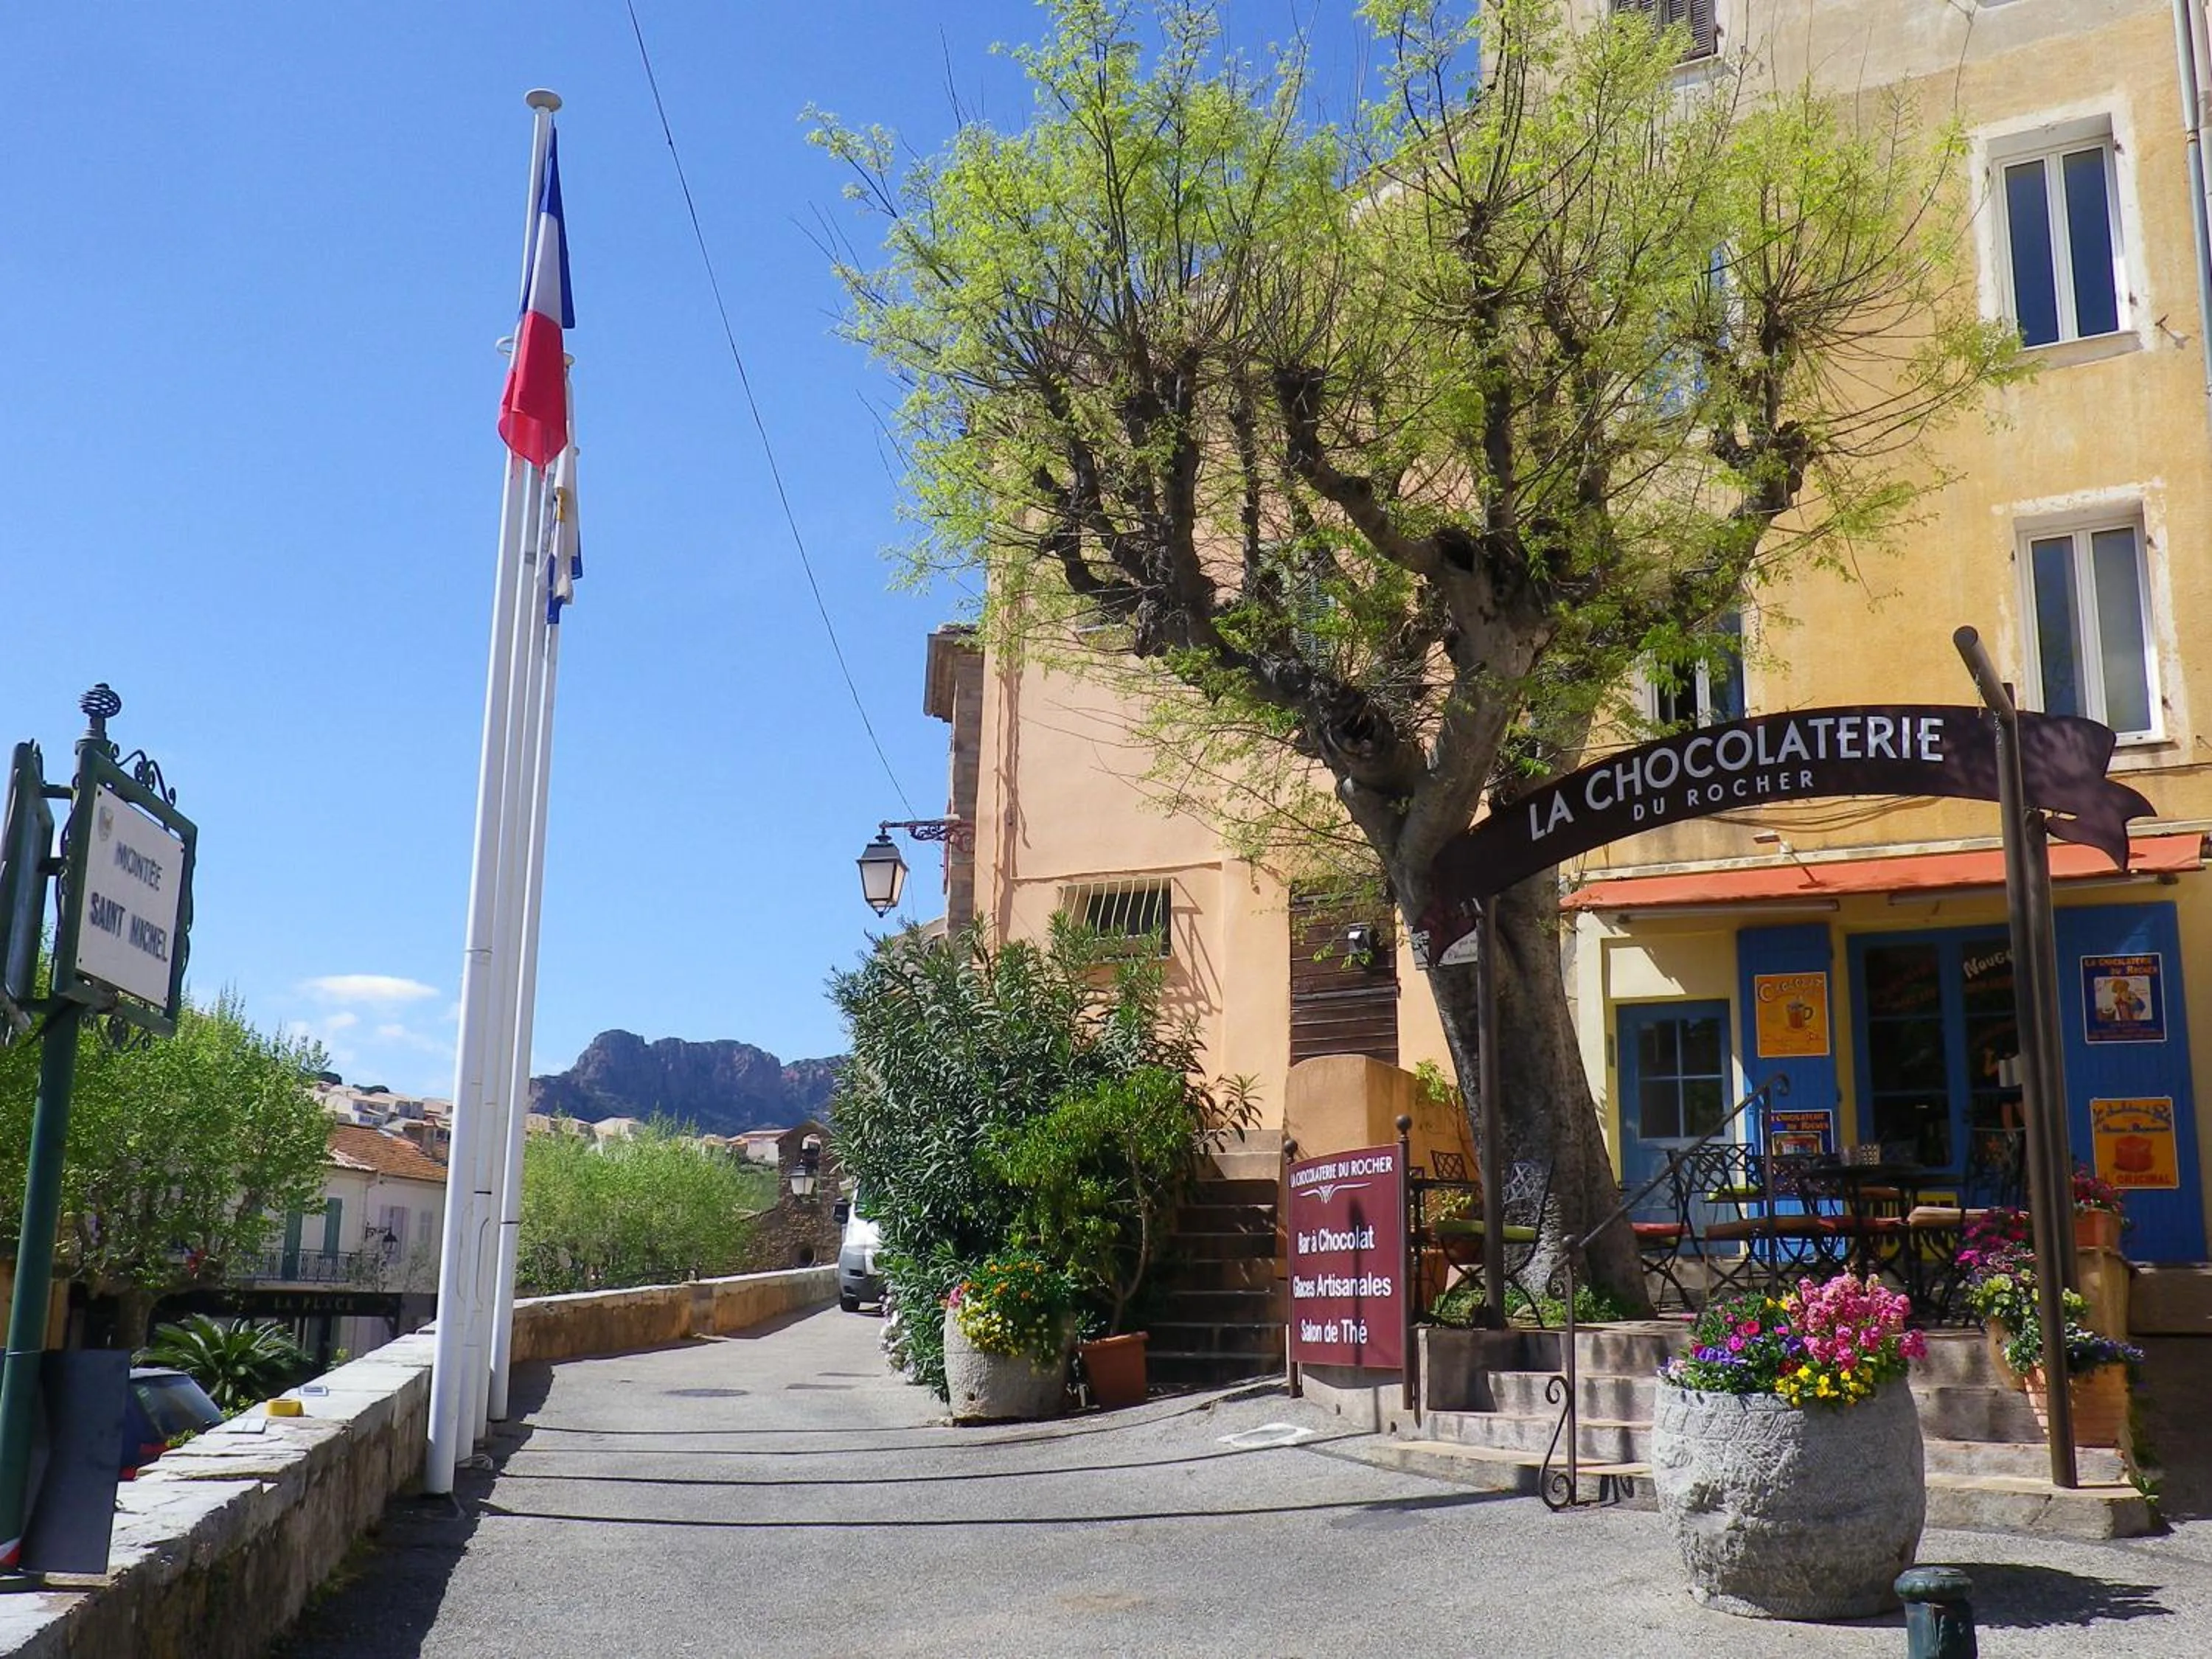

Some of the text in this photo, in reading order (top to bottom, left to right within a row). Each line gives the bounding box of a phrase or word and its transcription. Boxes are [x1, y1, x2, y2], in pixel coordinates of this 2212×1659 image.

[1528, 715, 1944, 842] LA CHOCOLATERIE
[1633, 770, 1815, 821] DU ROCHER
[89, 891, 168, 963] SAINT MICHEL
[1295, 1164, 1337, 1186] CHOCOLATERIE
[1338, 1162, 1350, 1180] DU
[1351, 1155, 1393, 1176] ROCHER
[1298, 1225, 1375, 1254] Bar à Chocolat
[1293, 1272, 1392, 1298] Glaces Artisanales
[1301, 1318, 1368, 1344] Salon de Thé
